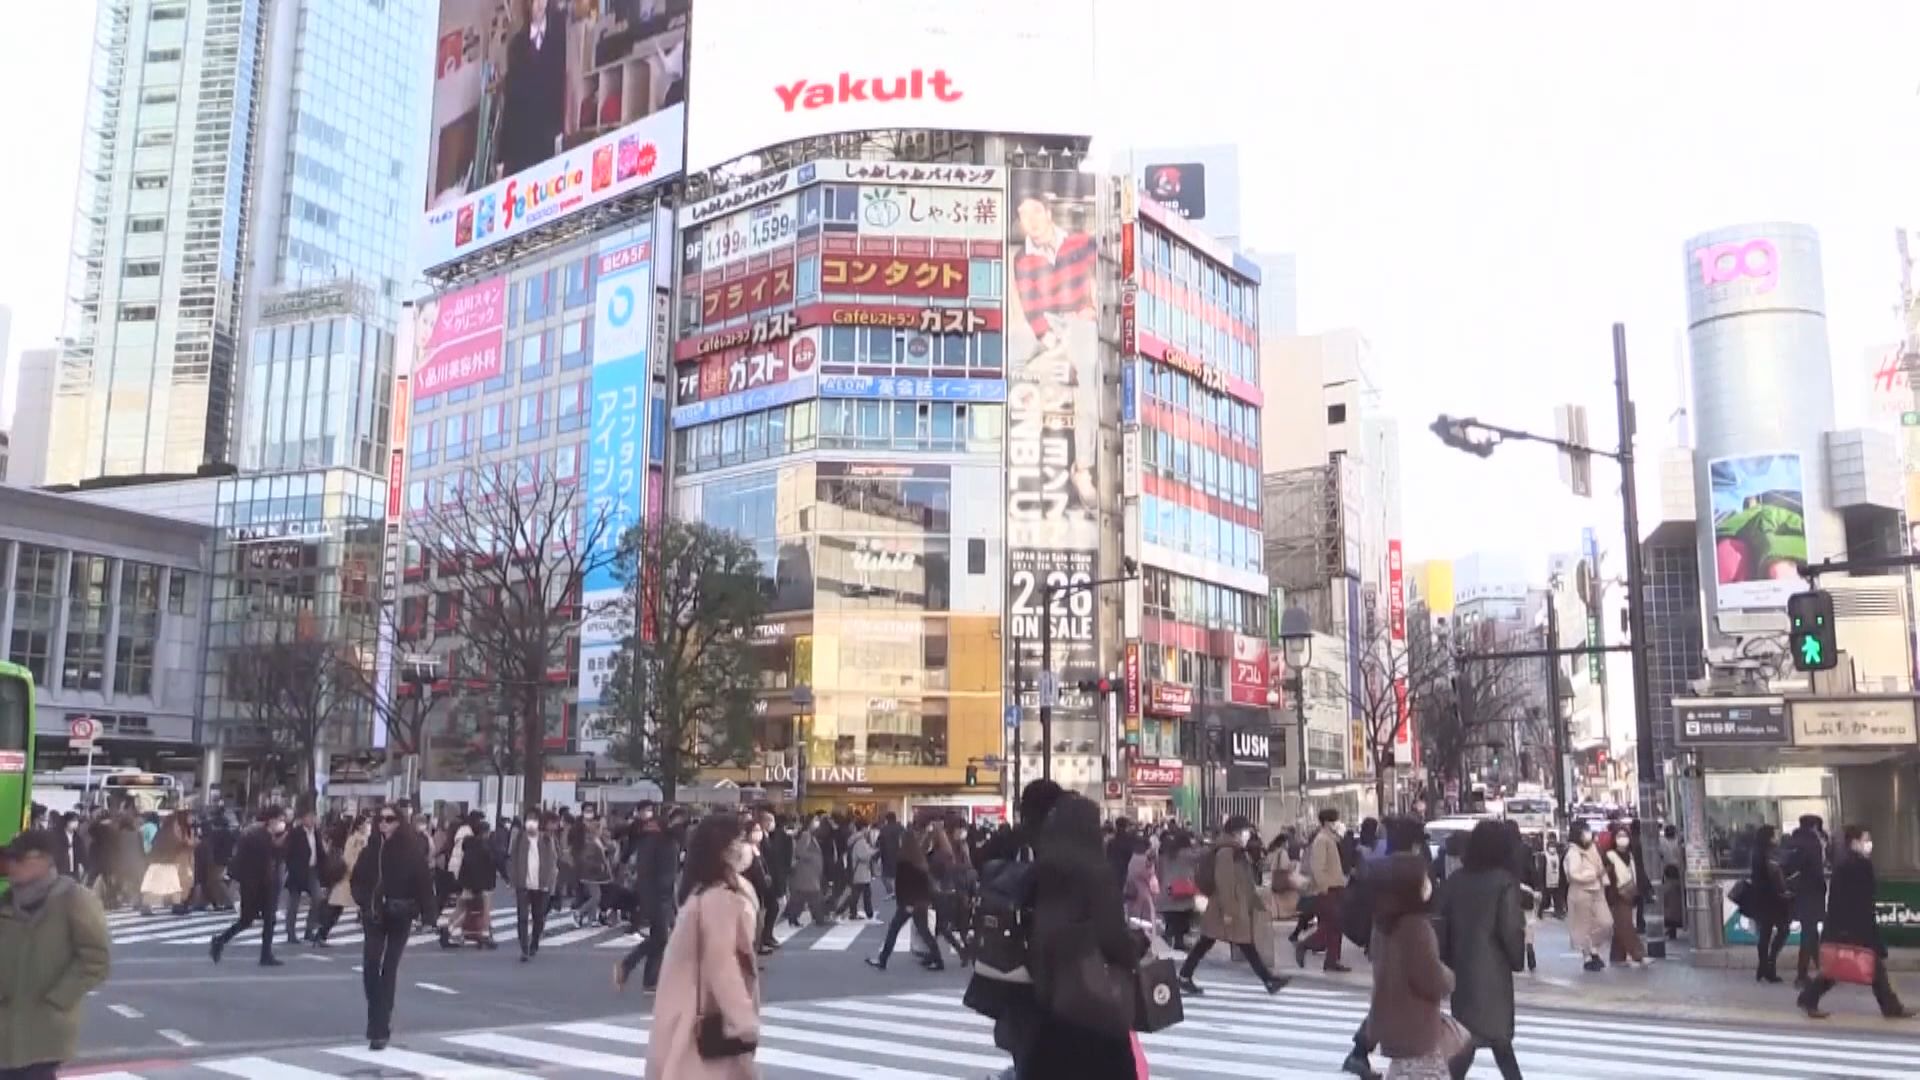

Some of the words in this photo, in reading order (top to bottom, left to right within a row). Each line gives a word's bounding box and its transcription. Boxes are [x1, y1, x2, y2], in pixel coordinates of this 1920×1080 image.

[774, 69, 964, 113] Yakult
[909, 197, 997, 225] しゃぶ葉
[686, 241, 702, 261] 9F
[822, 260, 964, 290] コンタクト
[752, 311, 798, 345] ガスト
[919, 306, 986, 333] ガスト
[424, 346, 497, 390] 品川美容外科
[679, 373, 699, 397] 7F
[729, 352, 785, 392] ガスト
[878, 378, 1001, 397] 英会話イーオン
[1011, 570, 1093, 617] 2.26
[1011, 615, 1039, 638] ON
[1049, 616, 1093, 639] SALE
[1237, 662, 1262, 684] アコム
[1232, 732, 1269, 758] LUSH
[765, 763, 867, 783] L'OCITANE
